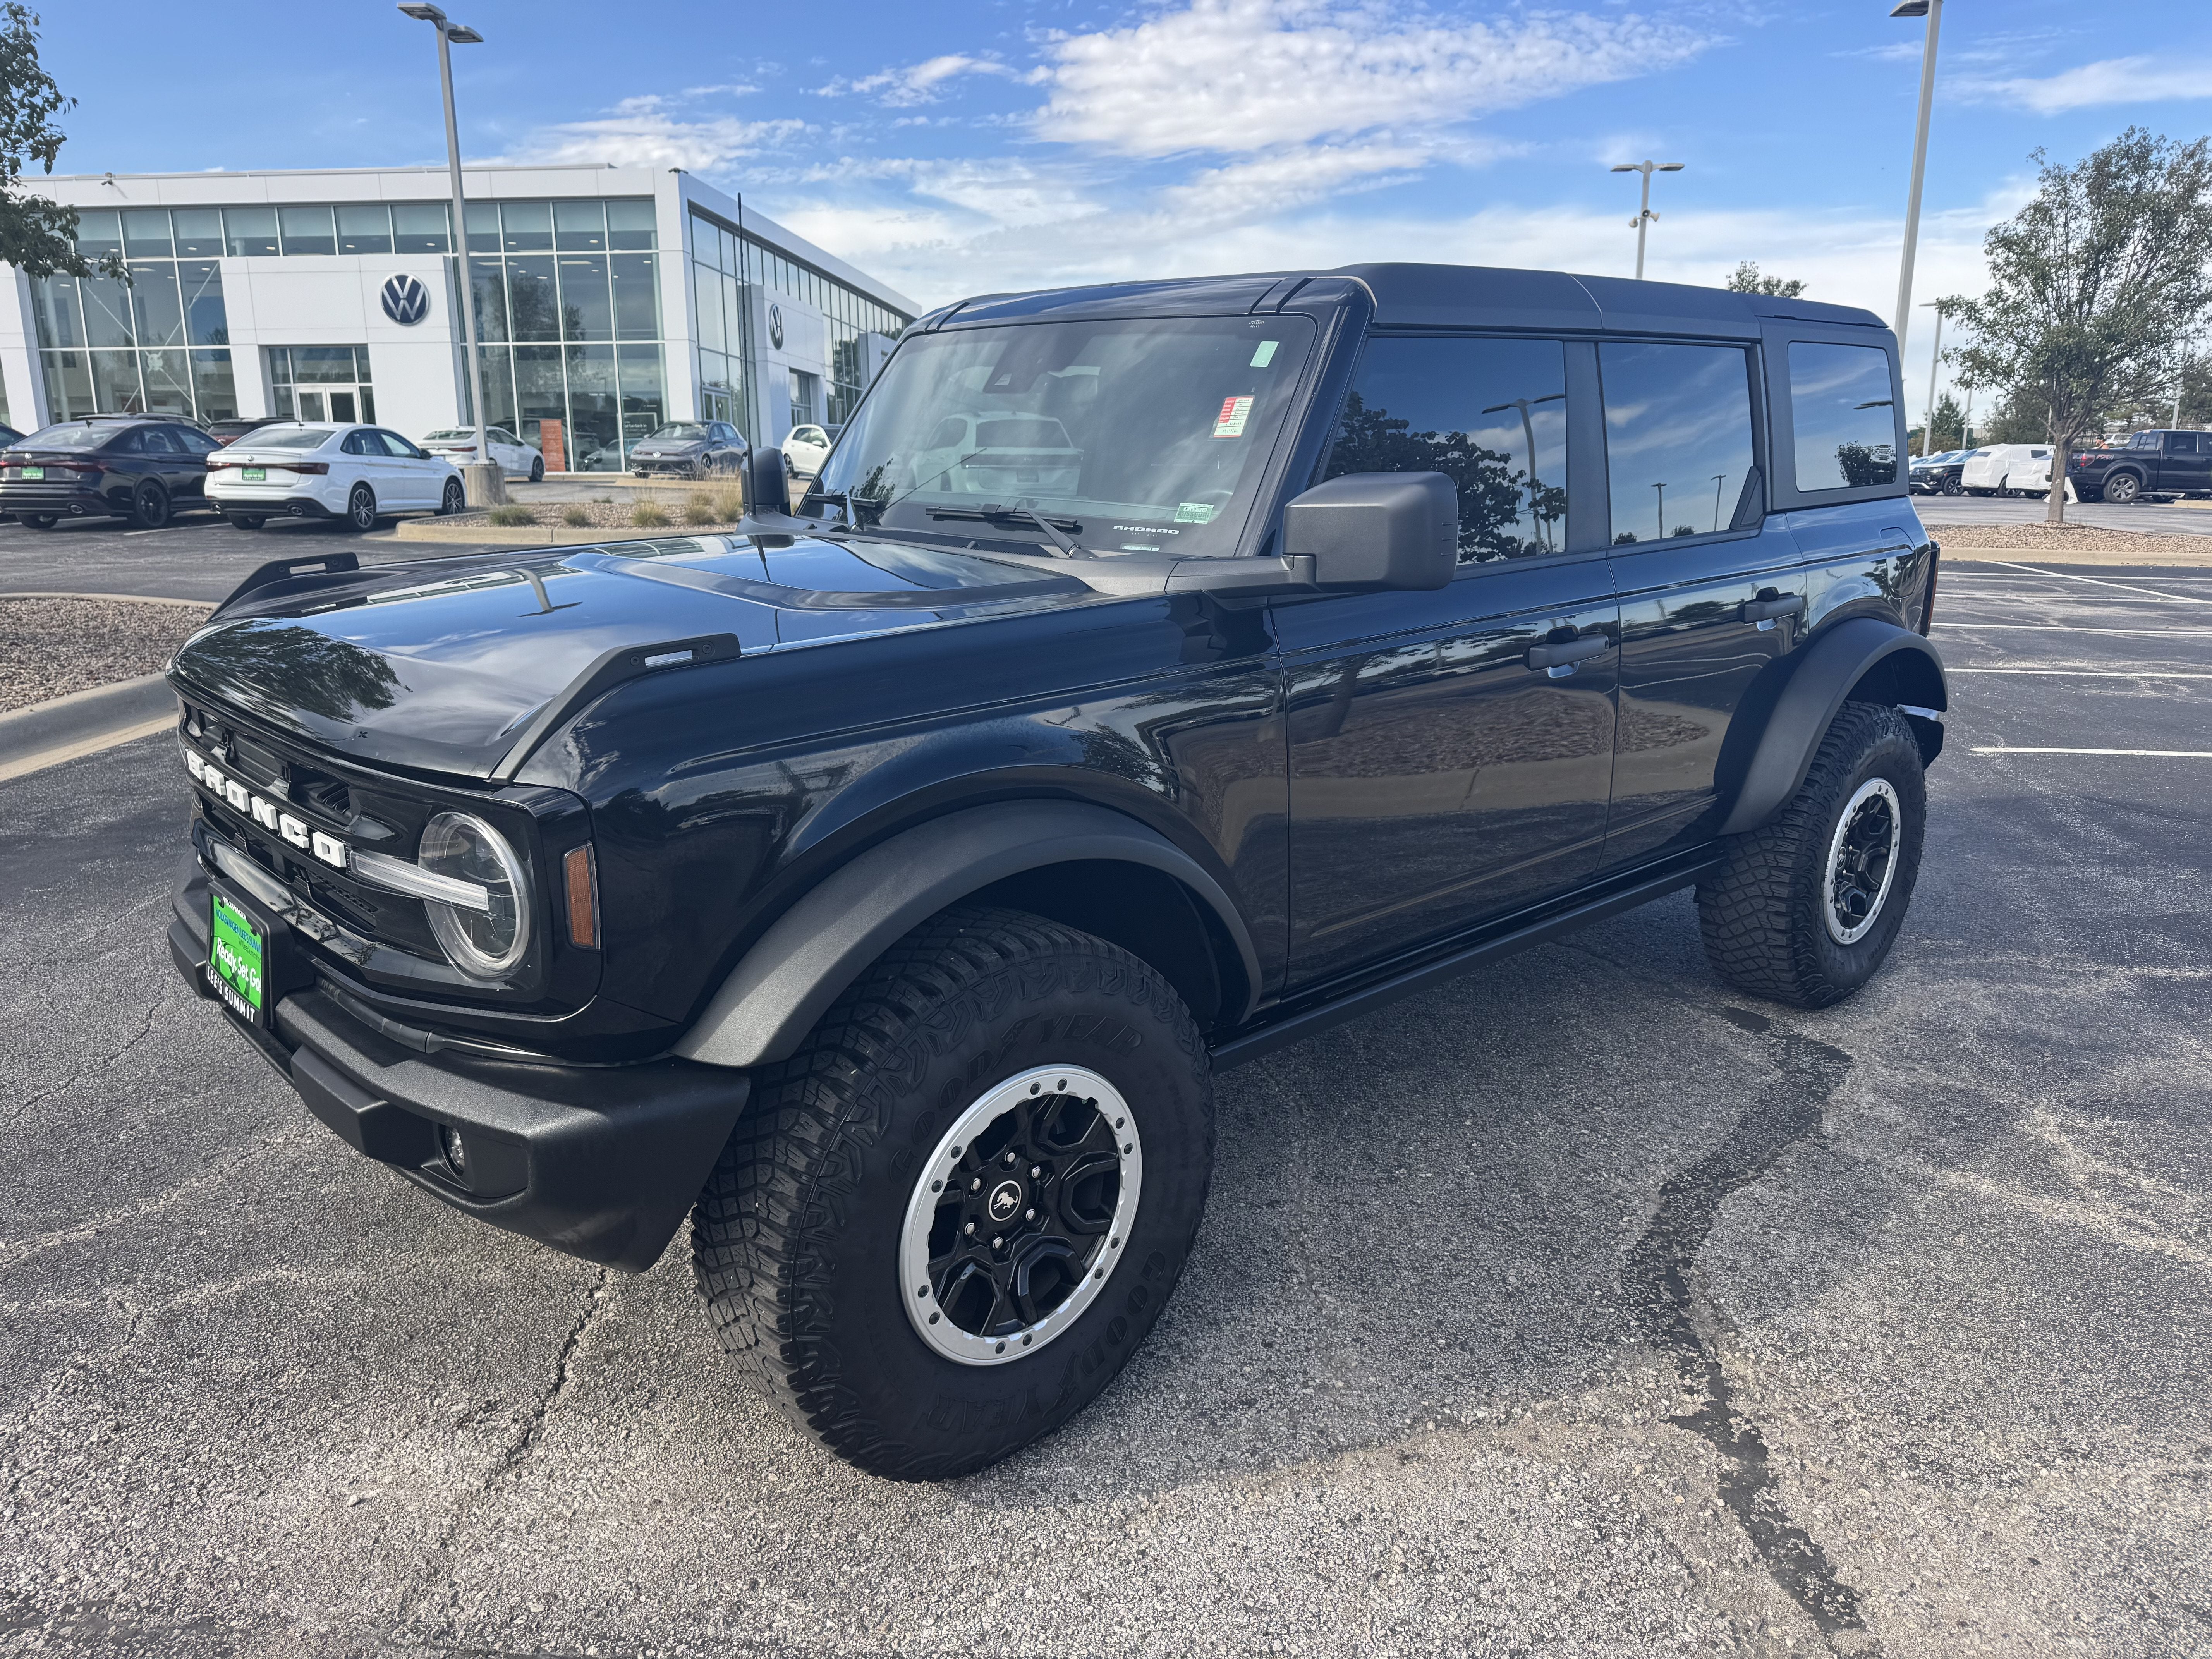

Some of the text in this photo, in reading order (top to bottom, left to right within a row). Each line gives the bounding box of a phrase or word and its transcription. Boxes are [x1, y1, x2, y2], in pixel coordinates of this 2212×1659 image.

[1113, 526, 1180, 534] BRONCO
[186, 750, 347, 868] BRONCO
[216, 907, 240, 936] VOLKSWAGEN
[207, 966, 255, 1022] LEE'S SUMMIT
[889, 1012, 1143, 1183] GOODYEAR
[927, 1250, 1166, 1432] GOODYEAR
